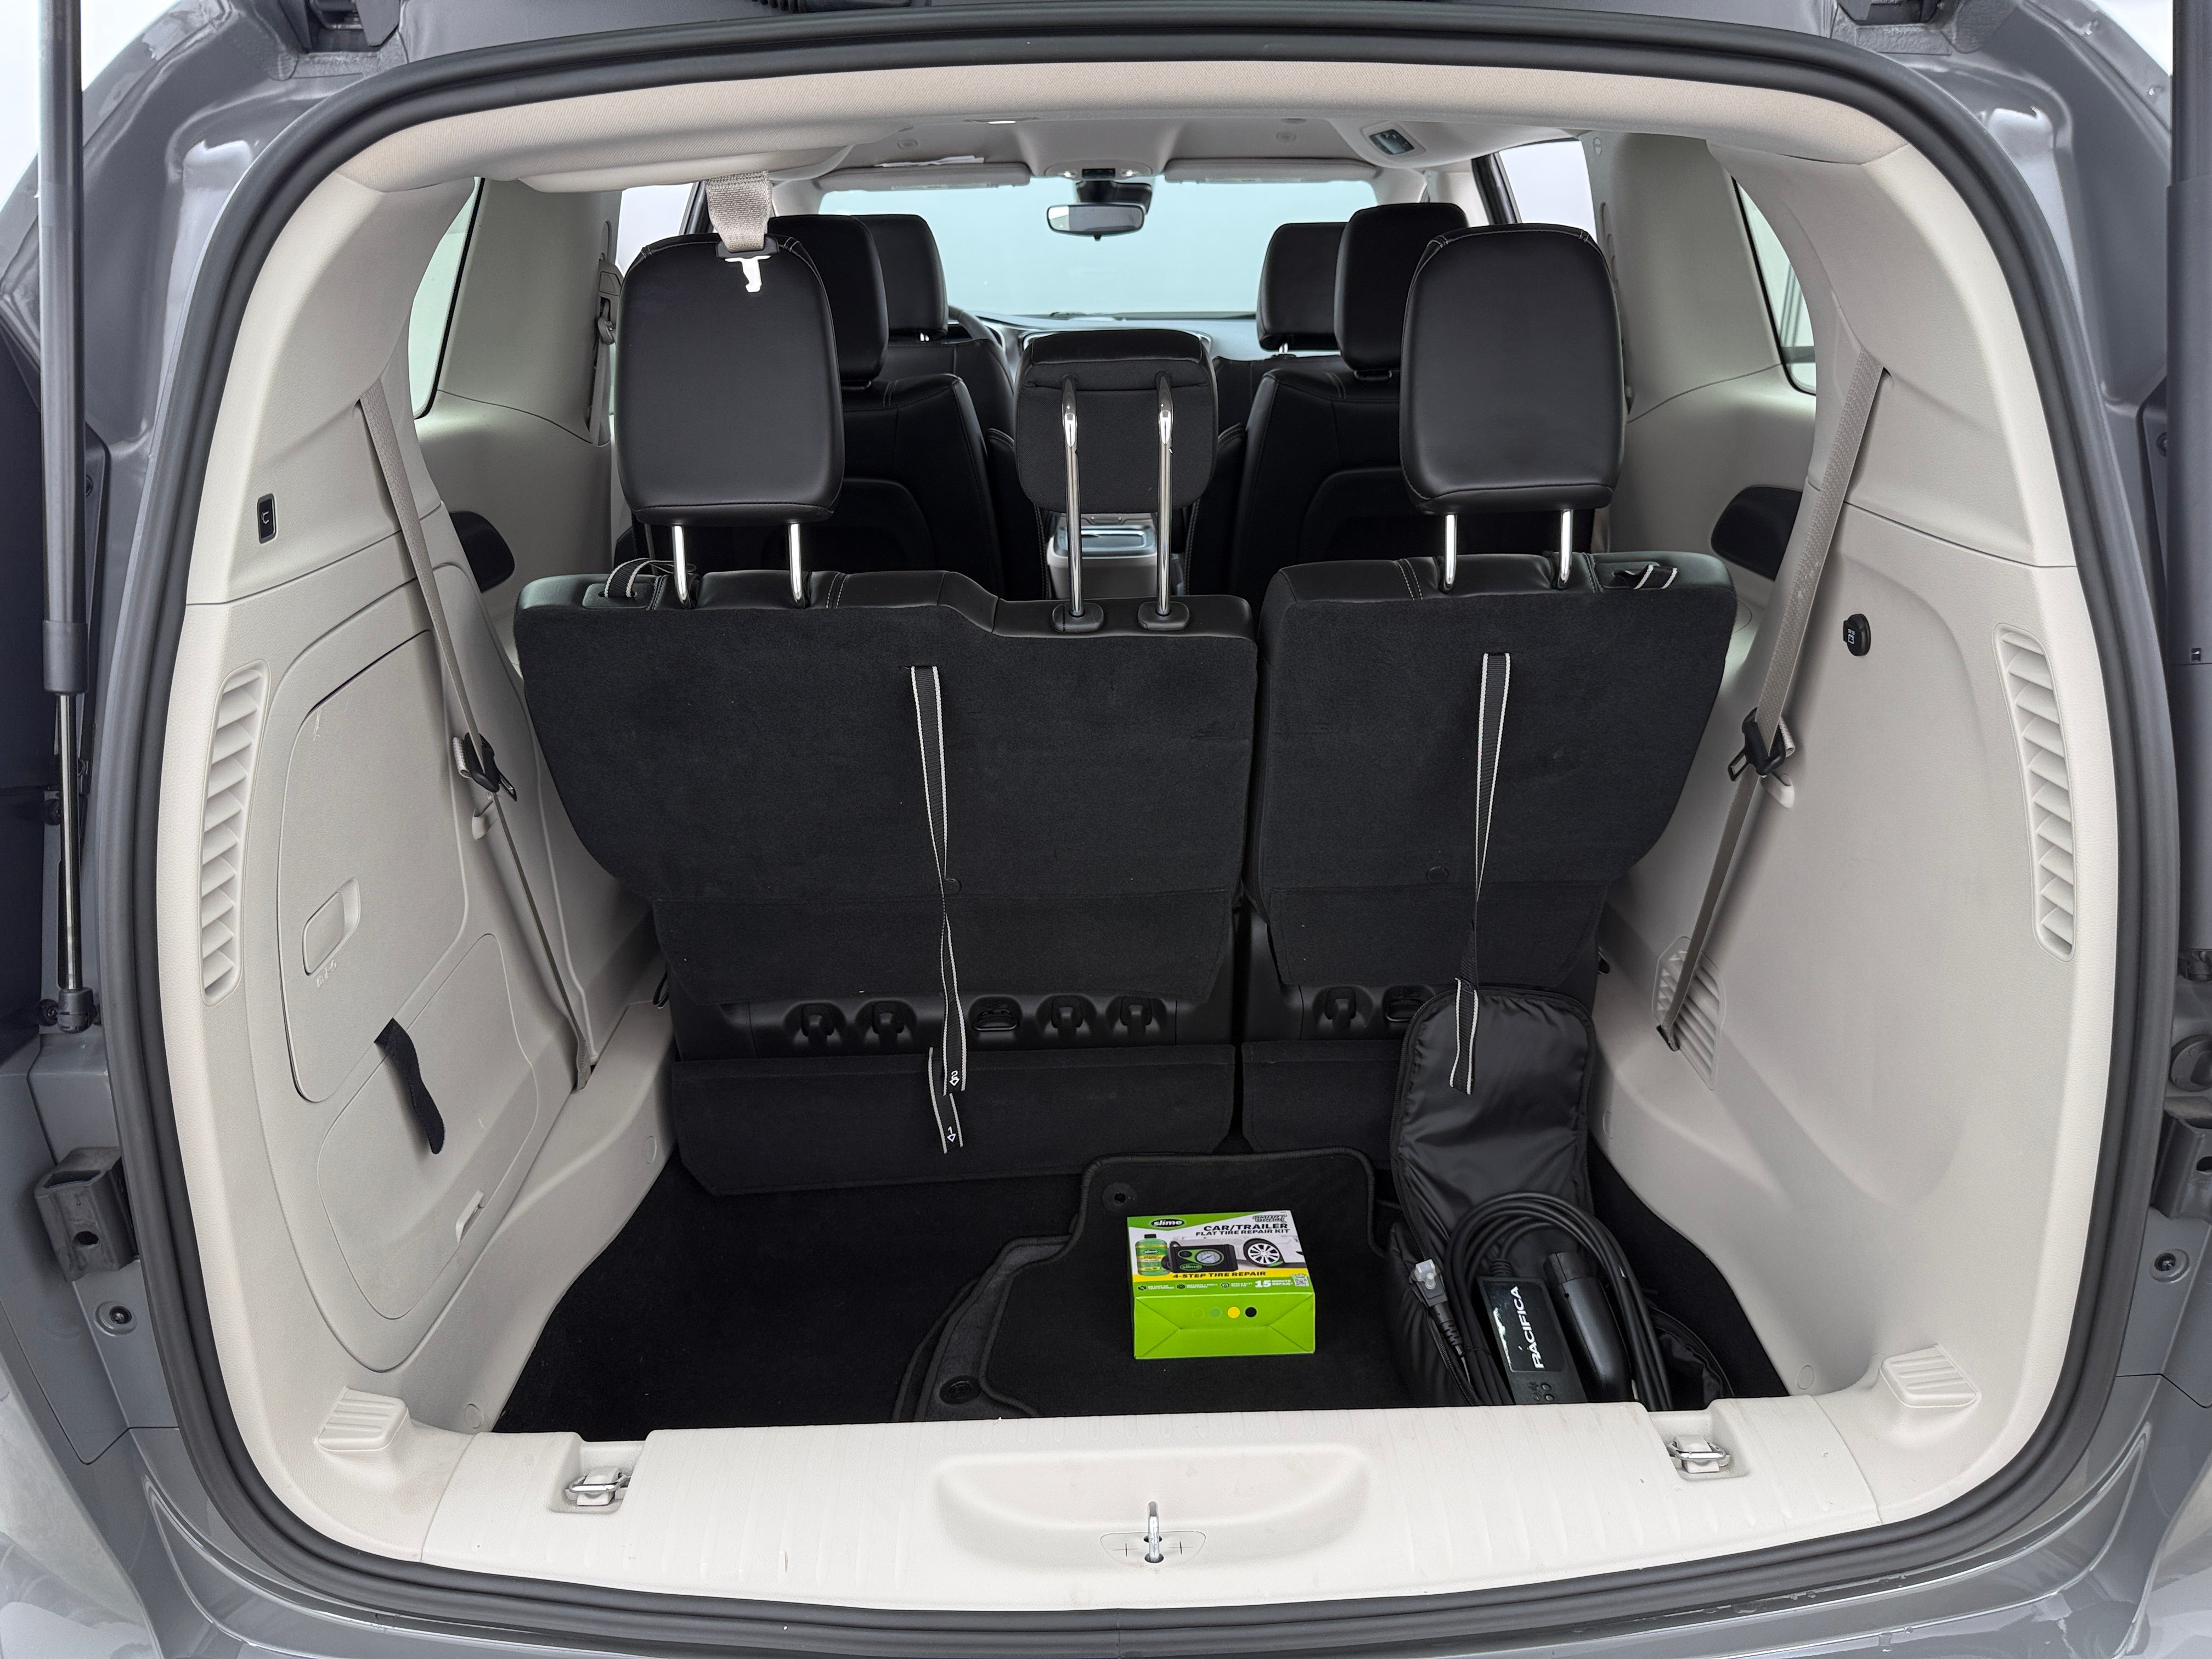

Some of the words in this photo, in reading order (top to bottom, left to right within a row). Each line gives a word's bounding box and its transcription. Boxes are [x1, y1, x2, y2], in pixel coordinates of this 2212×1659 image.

[951, 1070, 958, 1079] 2
[1255, 1280, 1272, 1288] 15
[1510, 1286, 1544, 1369] PACIFICA
